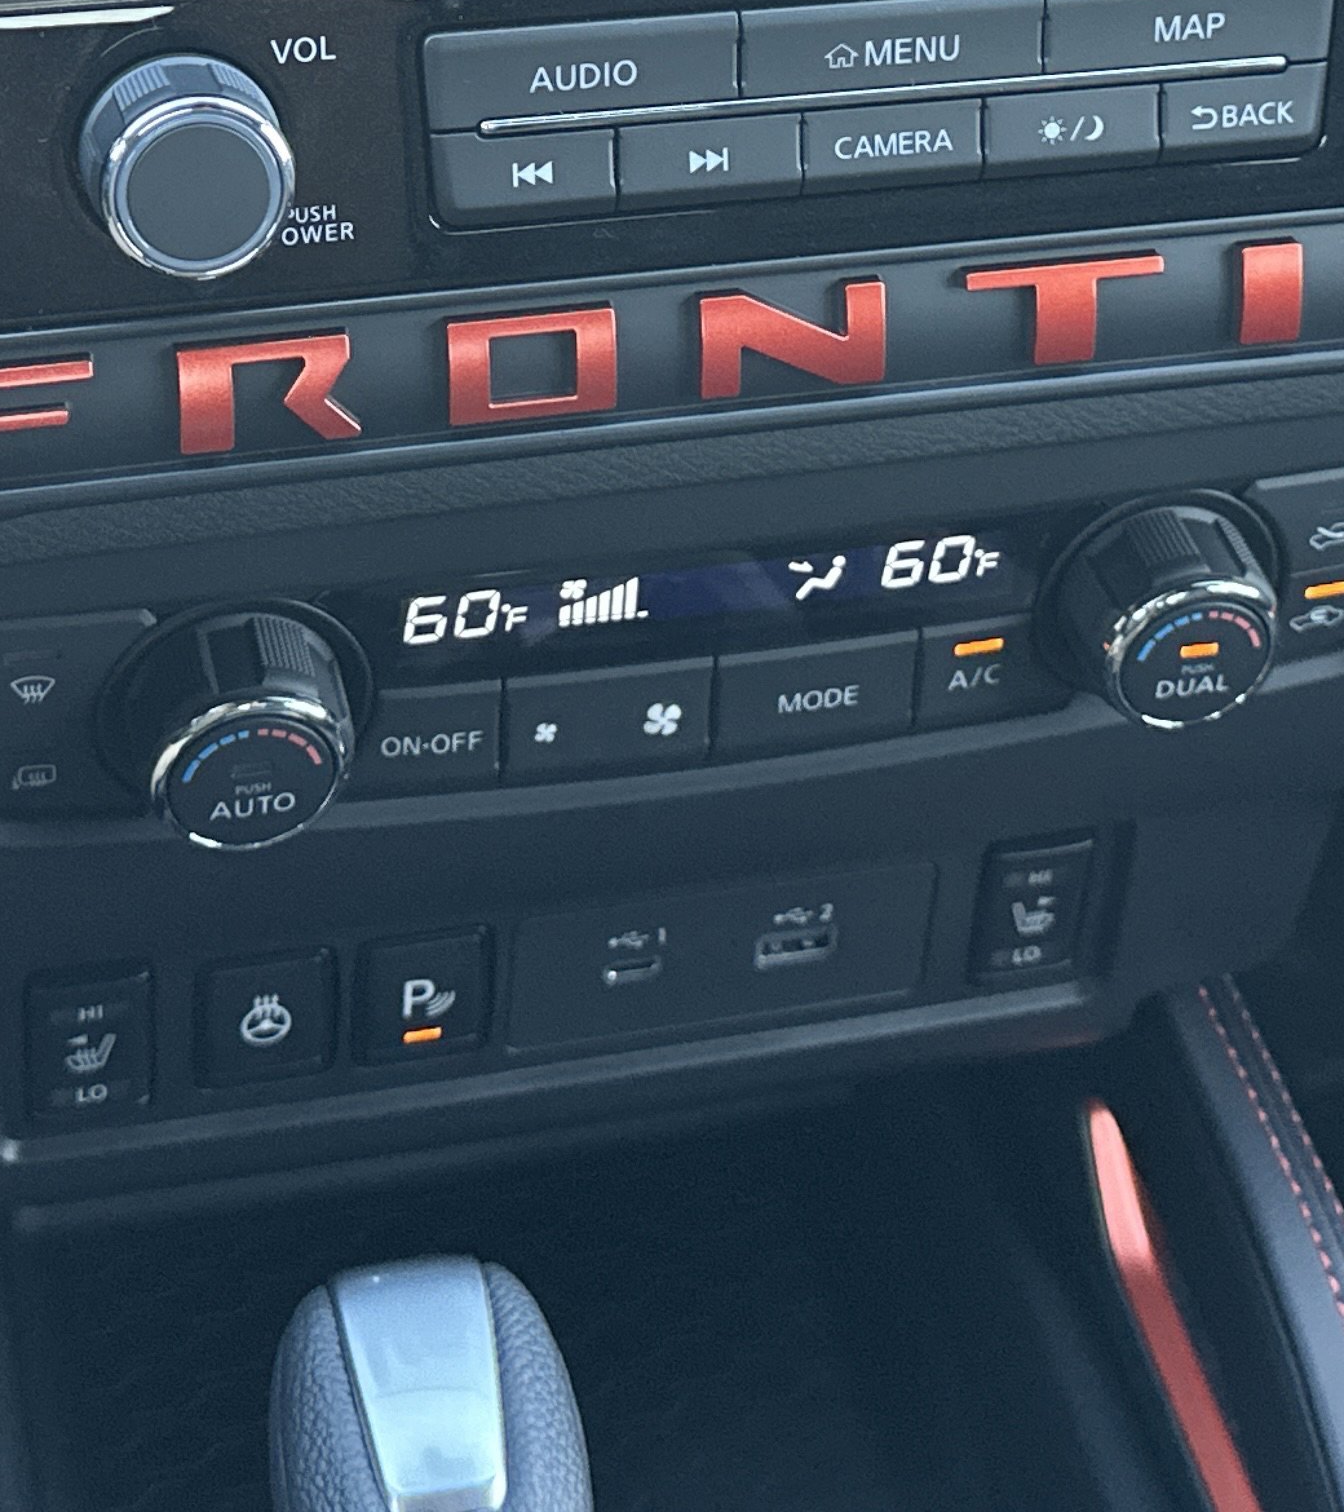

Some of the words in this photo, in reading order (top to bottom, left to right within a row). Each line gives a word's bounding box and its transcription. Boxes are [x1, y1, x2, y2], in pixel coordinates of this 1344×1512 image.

[1154, 12, 1226, 42] MAP
[270, 36, 336, 64] VOL
[864, 34, 960, 67] MENU
[529, 59, 638, 93] AUDIO
[1221, 100, 1294, 128] BACK
[834, 128, 953, 160] CAMERA
[282, 222, 355, 246] OWER
[948, 663, 1001, 691] A/C
[1155, 674, 1229, 699] DUAL
[777, 684, 860, 714] MODE
[209, 792, 296, 821] AUTO
[77, 1004, 104, 1022] HI
[77, 1084, 108, 1105] LO
